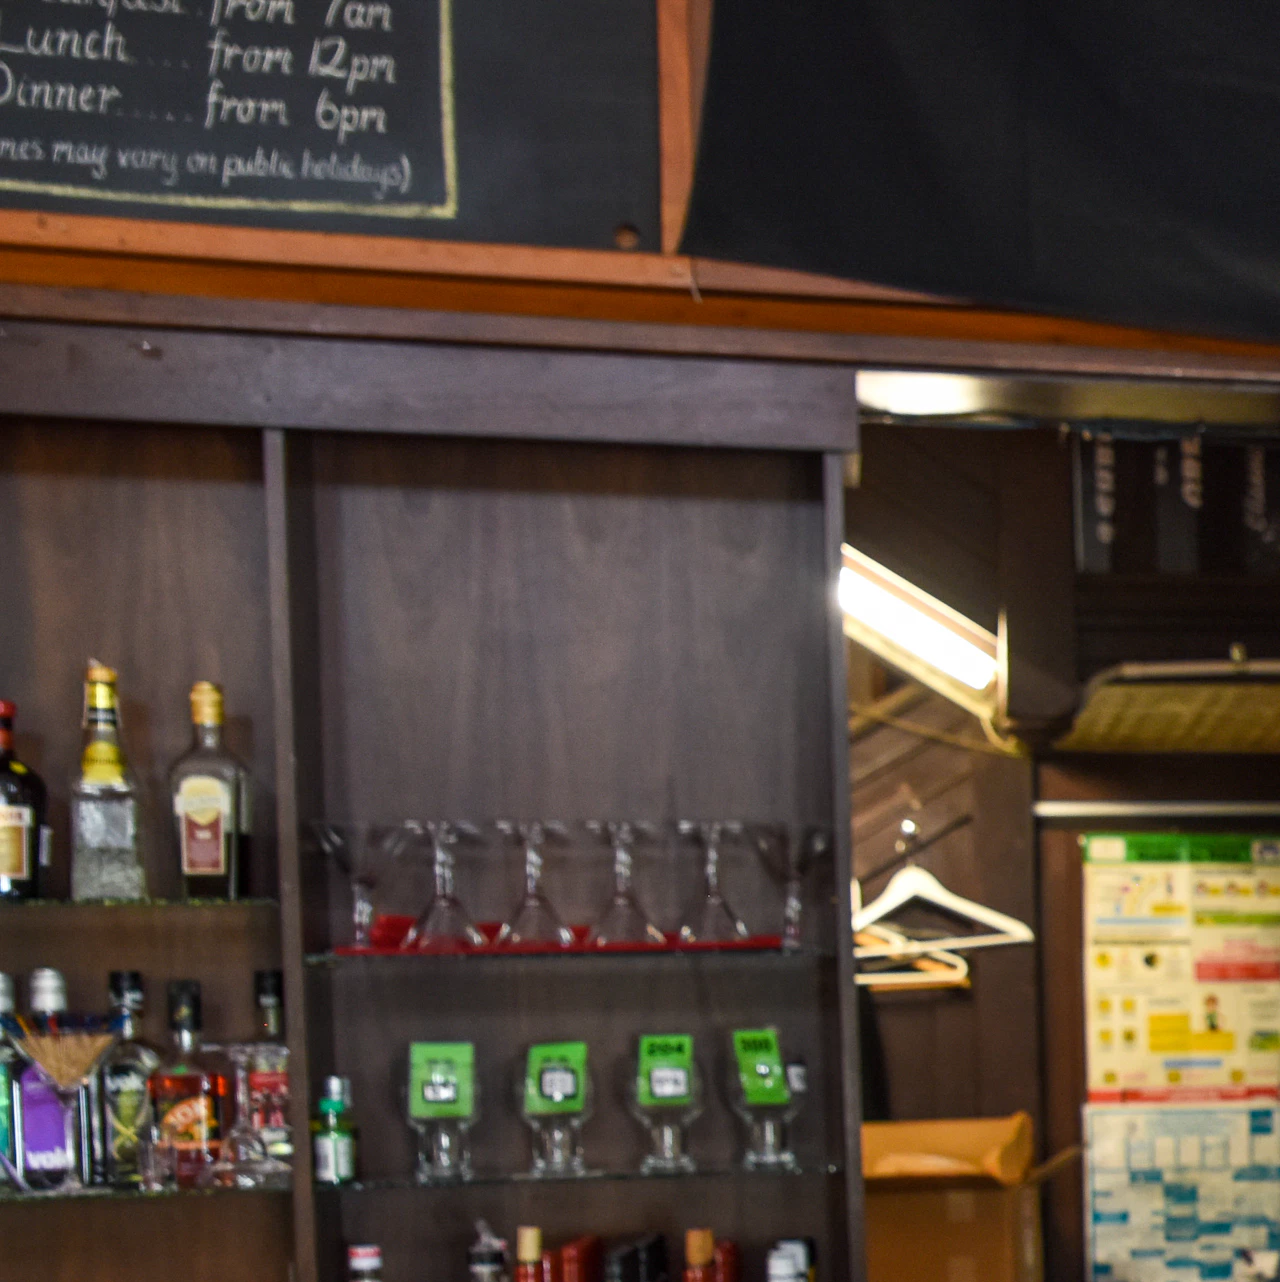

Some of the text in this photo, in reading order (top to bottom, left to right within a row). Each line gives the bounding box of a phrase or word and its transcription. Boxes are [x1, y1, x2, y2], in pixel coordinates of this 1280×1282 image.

[207, 28, 292, 76] from
[308, 37, 396, 95] 12pm
[205, 78, 289, 129] from
[315, 88, 387, 145] 6pm
[52, 140, 108, 179] may
[117, 147, 179, 187] vary
[187, 152, 217, 174] on
